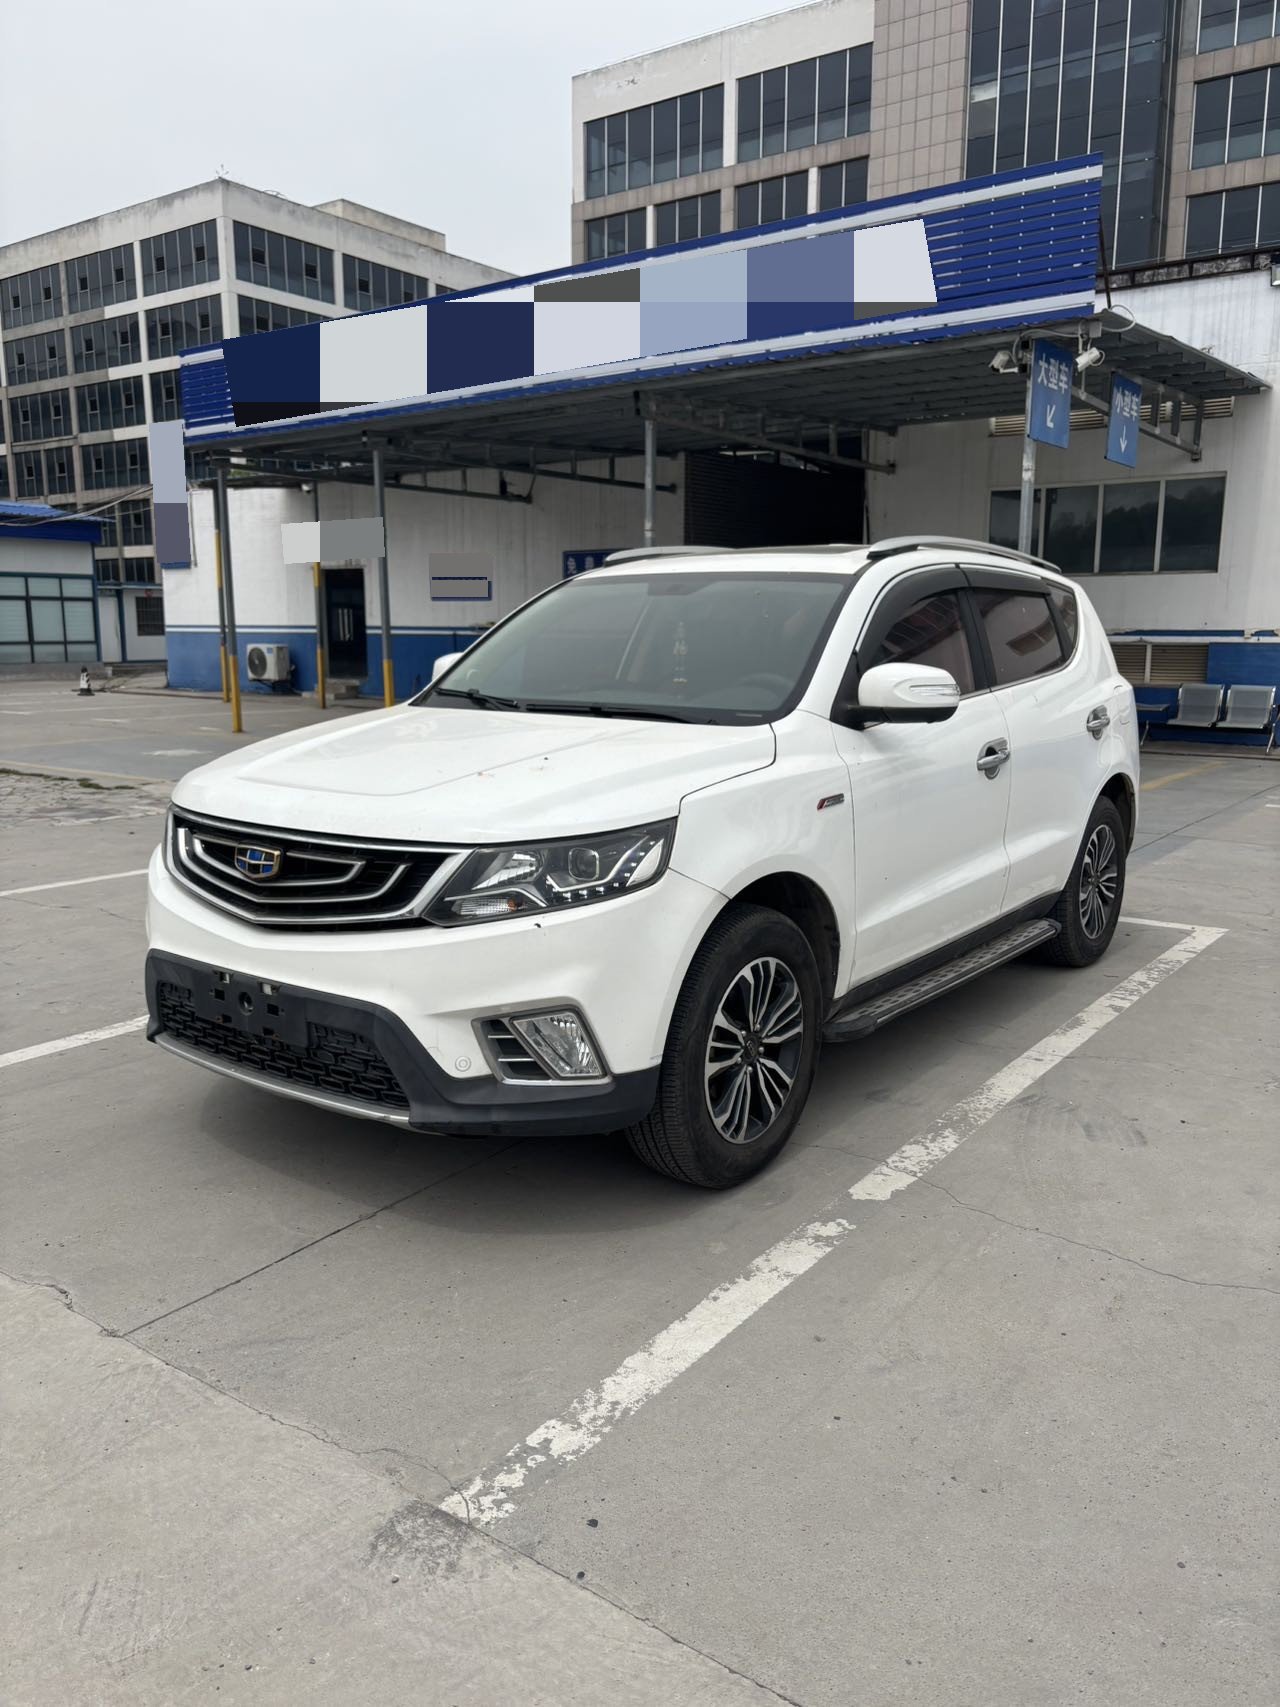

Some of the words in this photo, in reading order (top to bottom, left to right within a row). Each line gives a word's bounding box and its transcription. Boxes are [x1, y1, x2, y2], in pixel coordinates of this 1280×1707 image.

[1037, 352, 1069, 395] 大型车
[1115, 386, 1138, 421] 小型车
